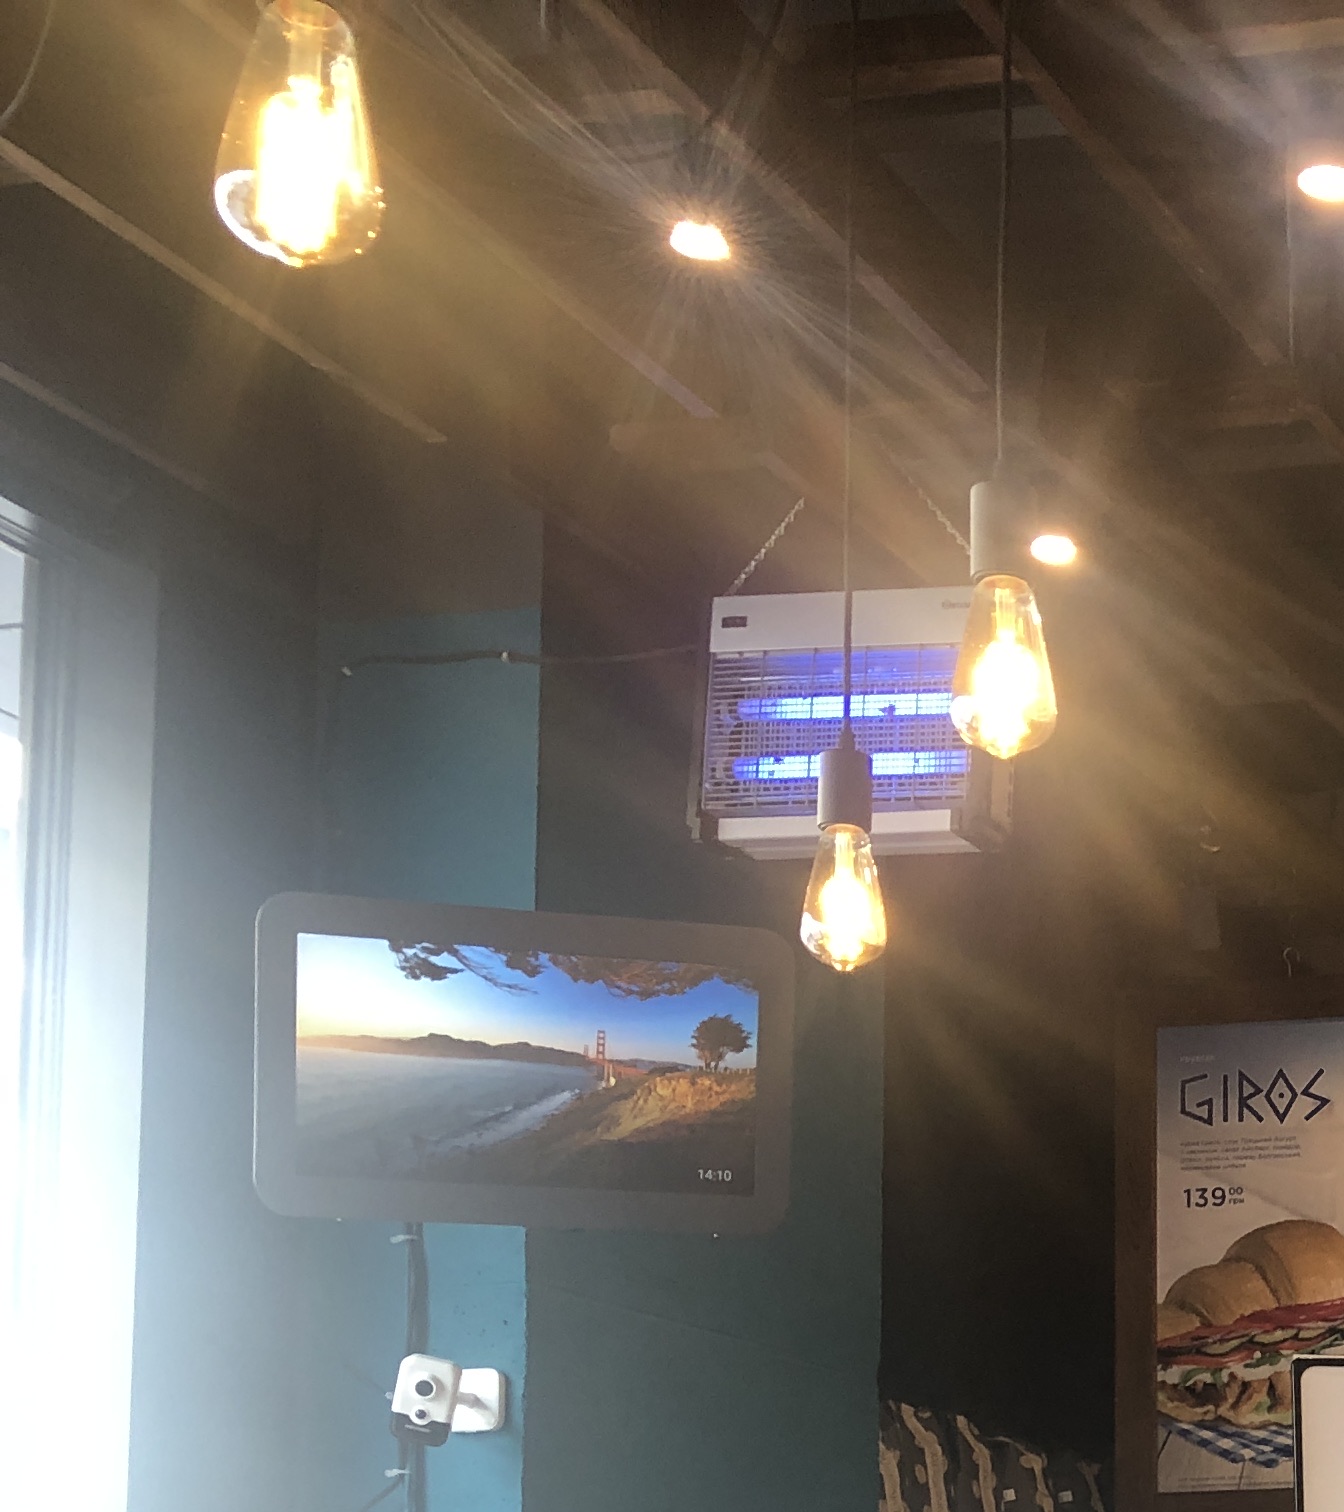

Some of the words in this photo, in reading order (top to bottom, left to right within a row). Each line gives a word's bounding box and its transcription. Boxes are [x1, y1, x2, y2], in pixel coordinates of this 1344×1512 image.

[1180, 1068, 1331, 1127] GIROS
[698, 1169, 732, 1181] 14:10
[1183, 1186, 1227, 1208] 139
[1228, 1186, 1244, 1196] 00
